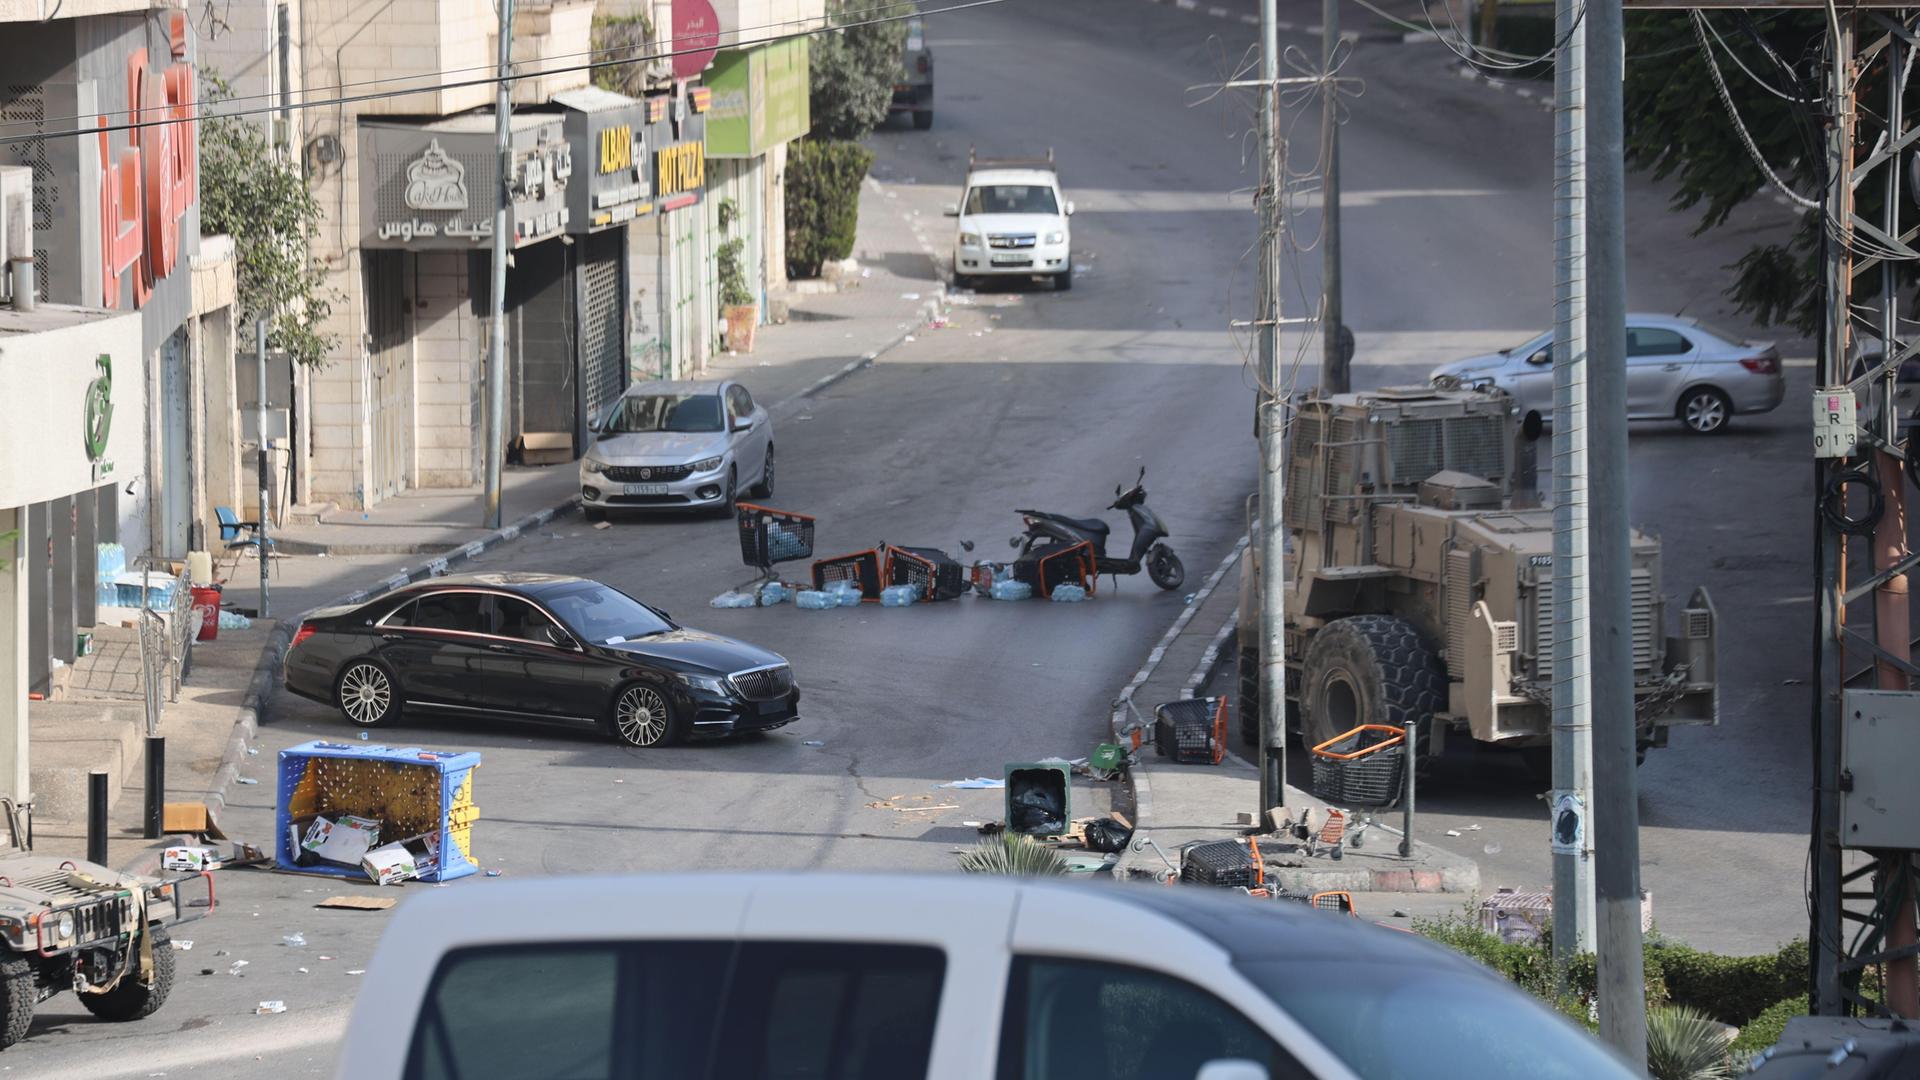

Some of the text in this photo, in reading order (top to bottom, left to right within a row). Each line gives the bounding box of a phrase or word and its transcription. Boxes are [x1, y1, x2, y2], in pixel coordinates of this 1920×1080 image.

[659, 141, 703, 196] HOT PIZZA
[379, 218, 437, 241] هاوس
[444, 217, 493, 241] كيك
[1830, 413, 1840, 425] R
